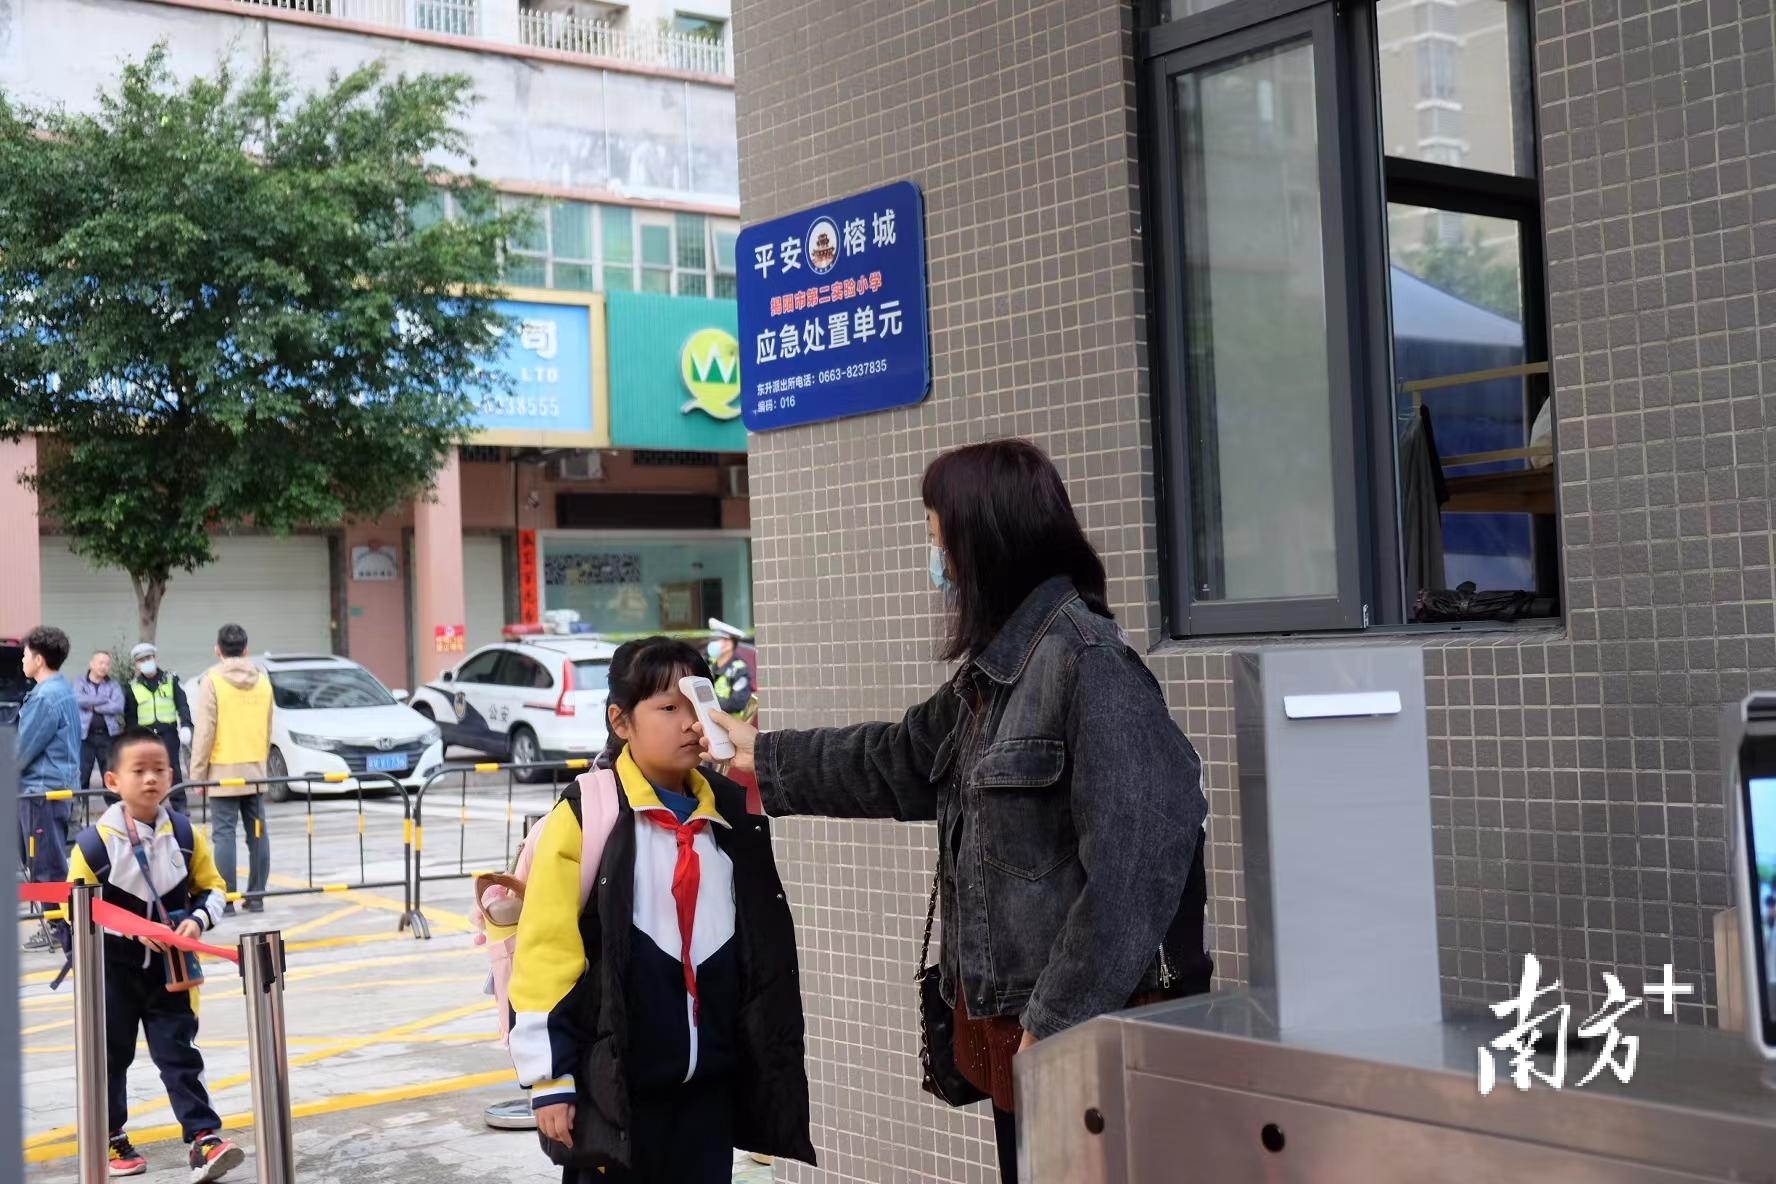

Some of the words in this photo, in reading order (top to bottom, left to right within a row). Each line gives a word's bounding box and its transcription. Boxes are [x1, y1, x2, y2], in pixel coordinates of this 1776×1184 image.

[754, 237, 802, 279] 平安
[843, 208, 897, 257] 榕城
[770, 270, 882, 317] 揭阳市第二实验小学
[756, 300, 903, 365] 应急处置单元
[521, 366, 558, 382] LTD
